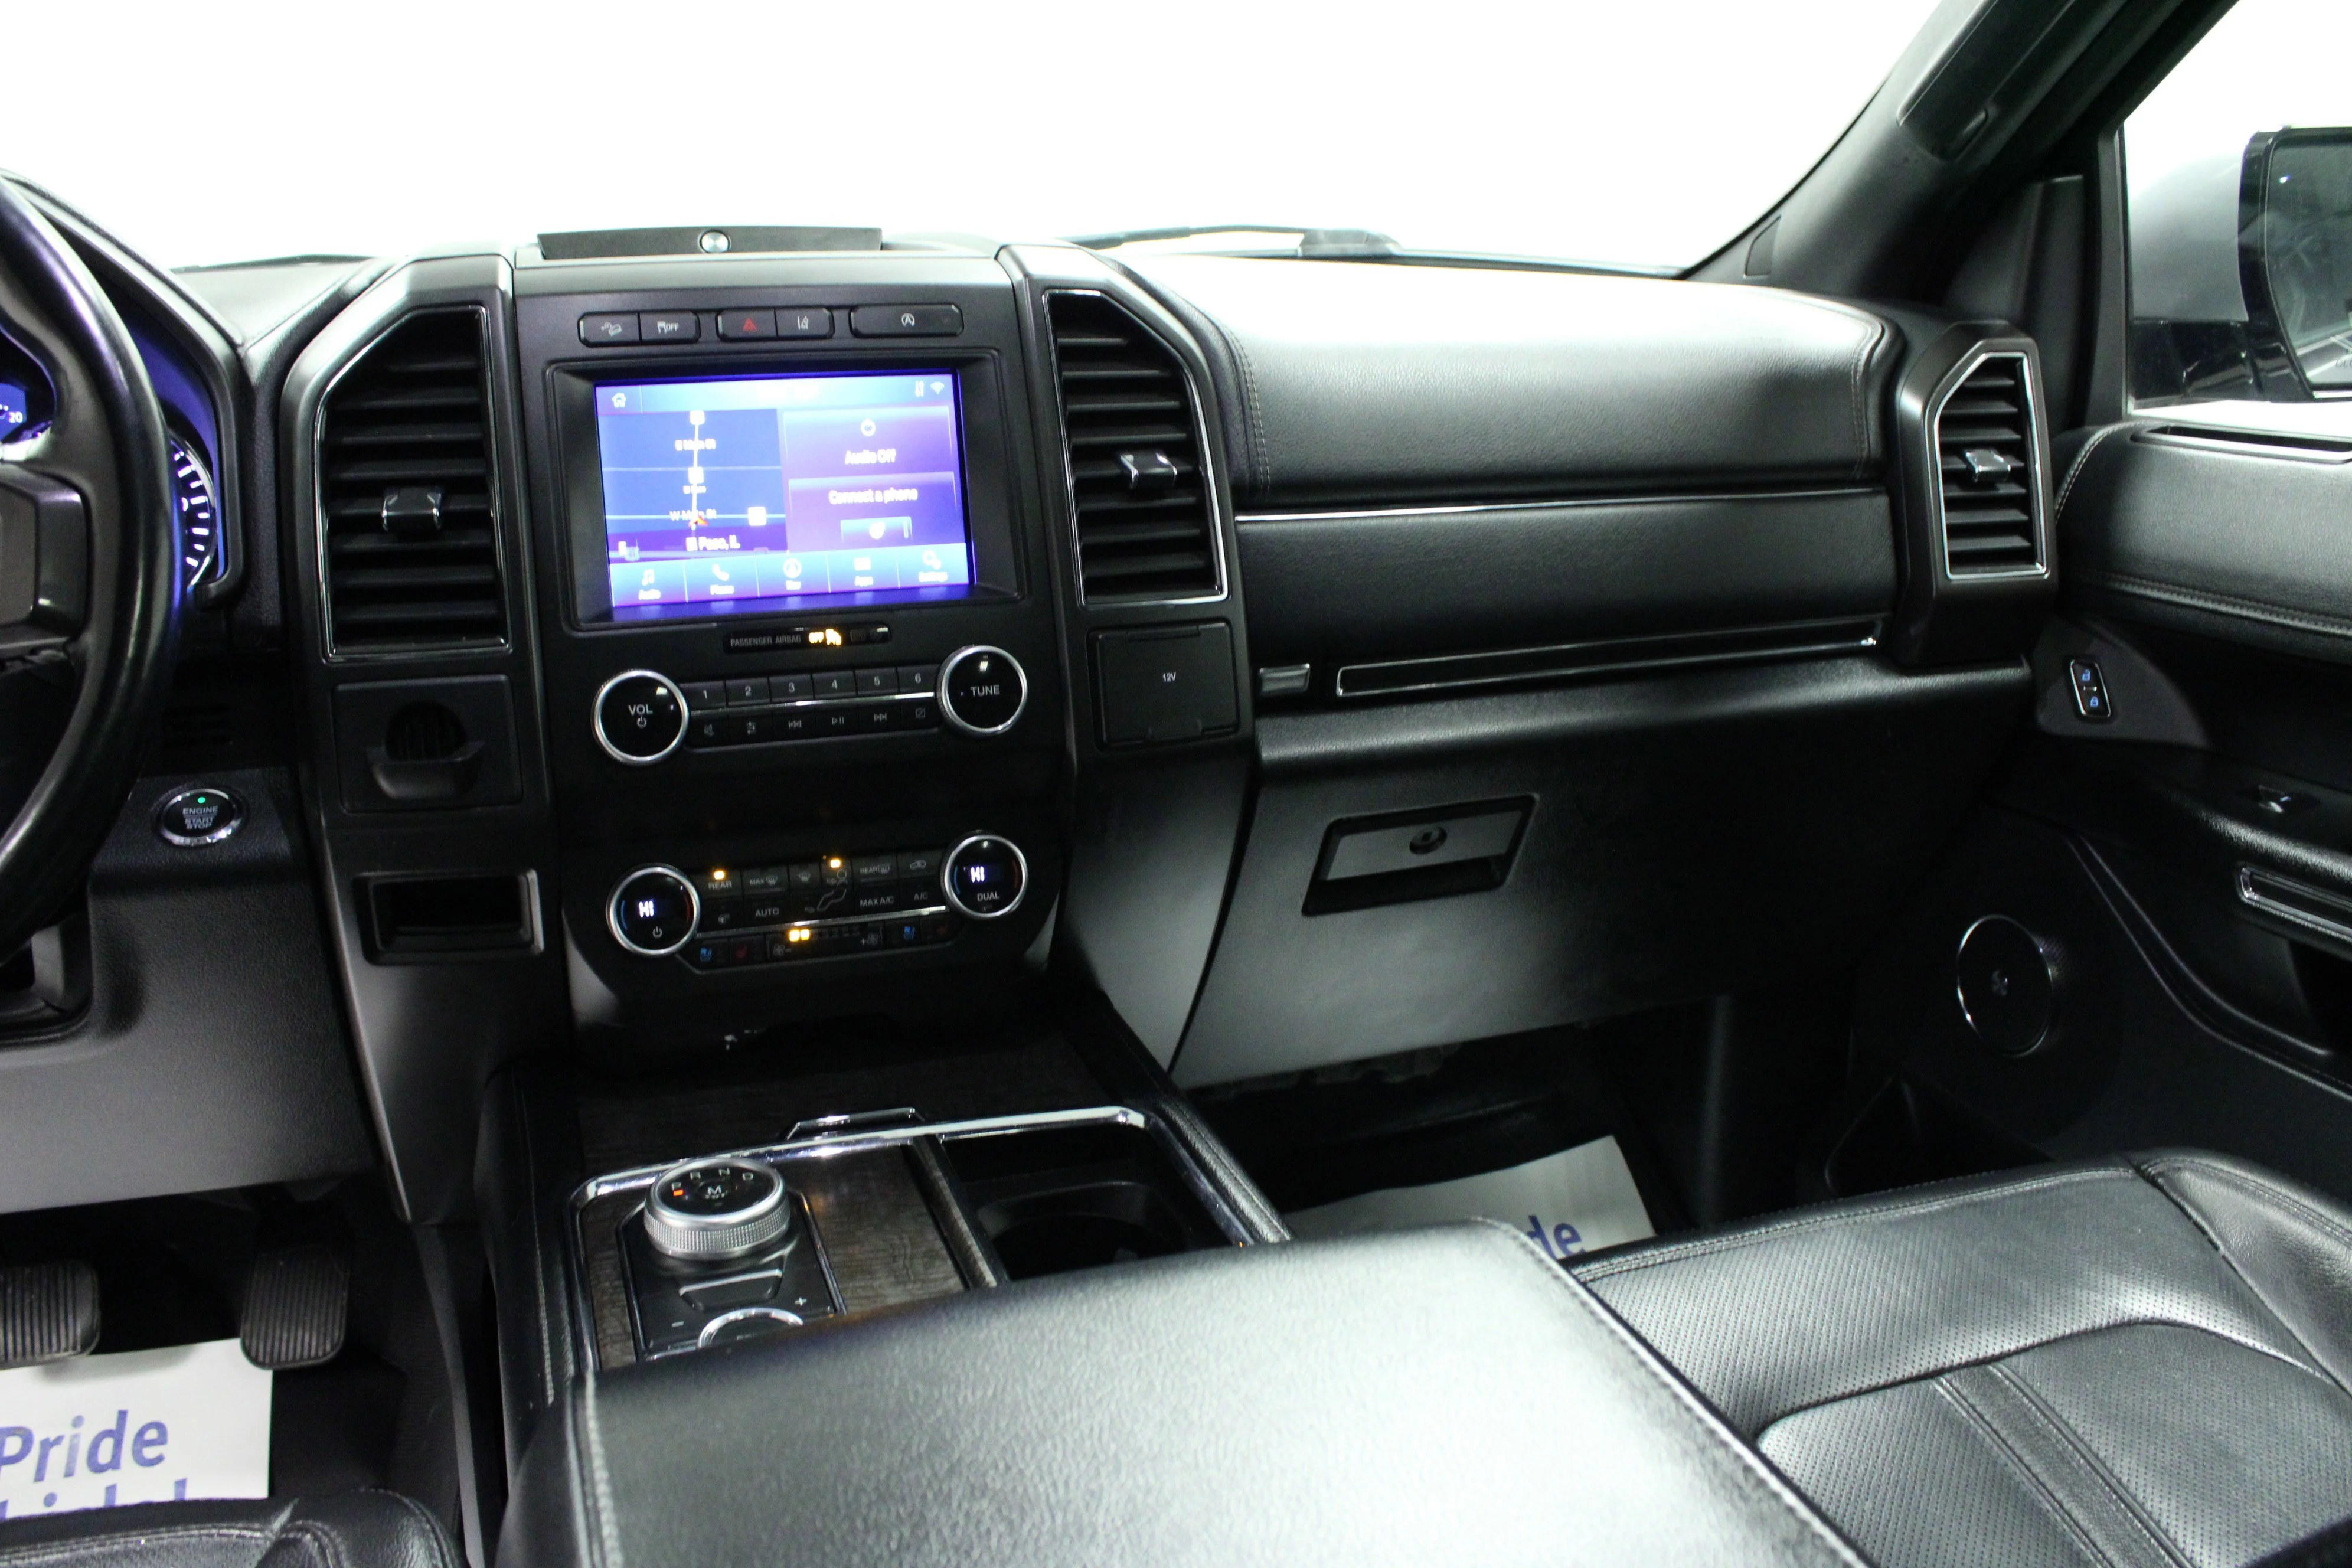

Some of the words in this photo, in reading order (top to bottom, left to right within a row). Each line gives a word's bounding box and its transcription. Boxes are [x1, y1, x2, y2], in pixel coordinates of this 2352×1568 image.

[845, 449, 877, 465] Audio
[878, 449, 896, 463] Off
[829, 489, 874, 504] Connect
[875, 491, 883, 502] a
[884, 487, 918, 504] phone
[730, 636, 772, 647] PASSENGER
[775, 635, 801, 644] AIRBAG
[874, 675, 880, 686] 5
[915, 673, 922, 684] 6
[1162, 671, 1177, 682] 12V
[789, 682, 795, 693] 3
[831, 679, 838, 690] 4
[703, 690, 707, 699] 1
[745, 686, 751, 697] 2
[970, 684, 1000, 697] TUNE
[628, 704, 653, 716] VOL
[182, 805, 218, 815] ENGINE
[708, 880, 732, 890] REAR
[860, 898, 878, 907] MAX
[880, 895, 894, 904] A/C
[914, 891, 929, 901] A/C
[977, 891, 1000, 901] DUAL
[755, 907, 779, 918] AUTO
[718, 1168, 730, 1176] N
[742, 1172, 754, 1181] D
[707, 1185, 722, 1195] M
[0, 1409, 168, 1482] Pride
